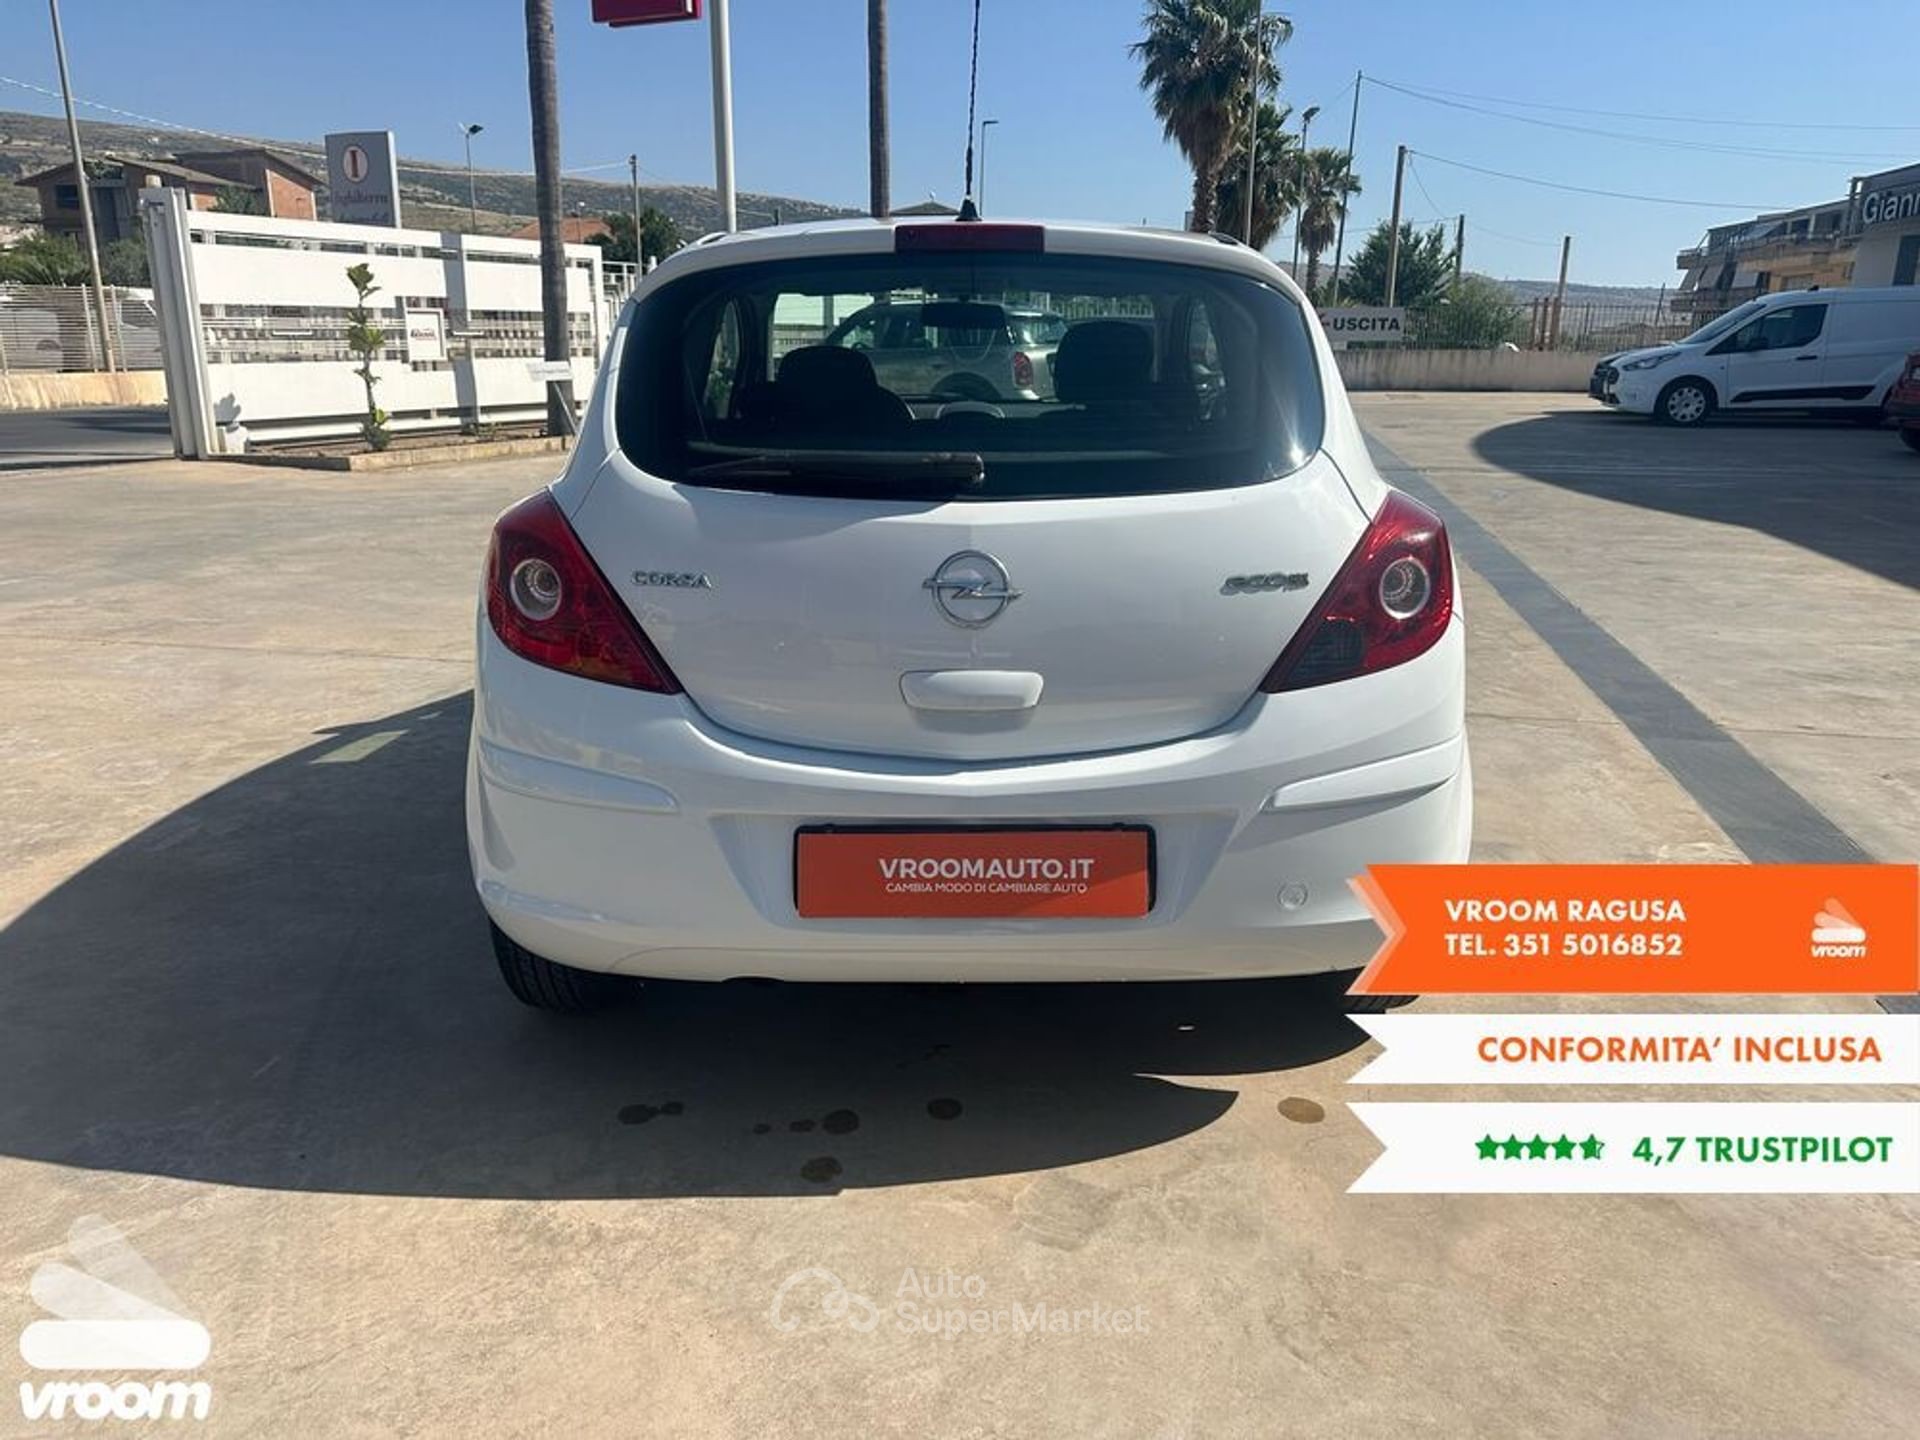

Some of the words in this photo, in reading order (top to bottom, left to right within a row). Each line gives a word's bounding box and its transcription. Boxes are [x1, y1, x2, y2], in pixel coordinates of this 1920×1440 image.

[1333, 317, 1401, 331] USCITA
[632, 571, 712, 588] CORSA
[878, 858, 1095, 879] VROOMAUTO.IT
[886, 882, 933, 893] CAMBIA
[935, 882, 973, 893] MODO
[974, 882, 986, 893] DI
[989, 882, 1051, 893] CAMBIARE
[1053, 882, 1088, 894] AUTO
